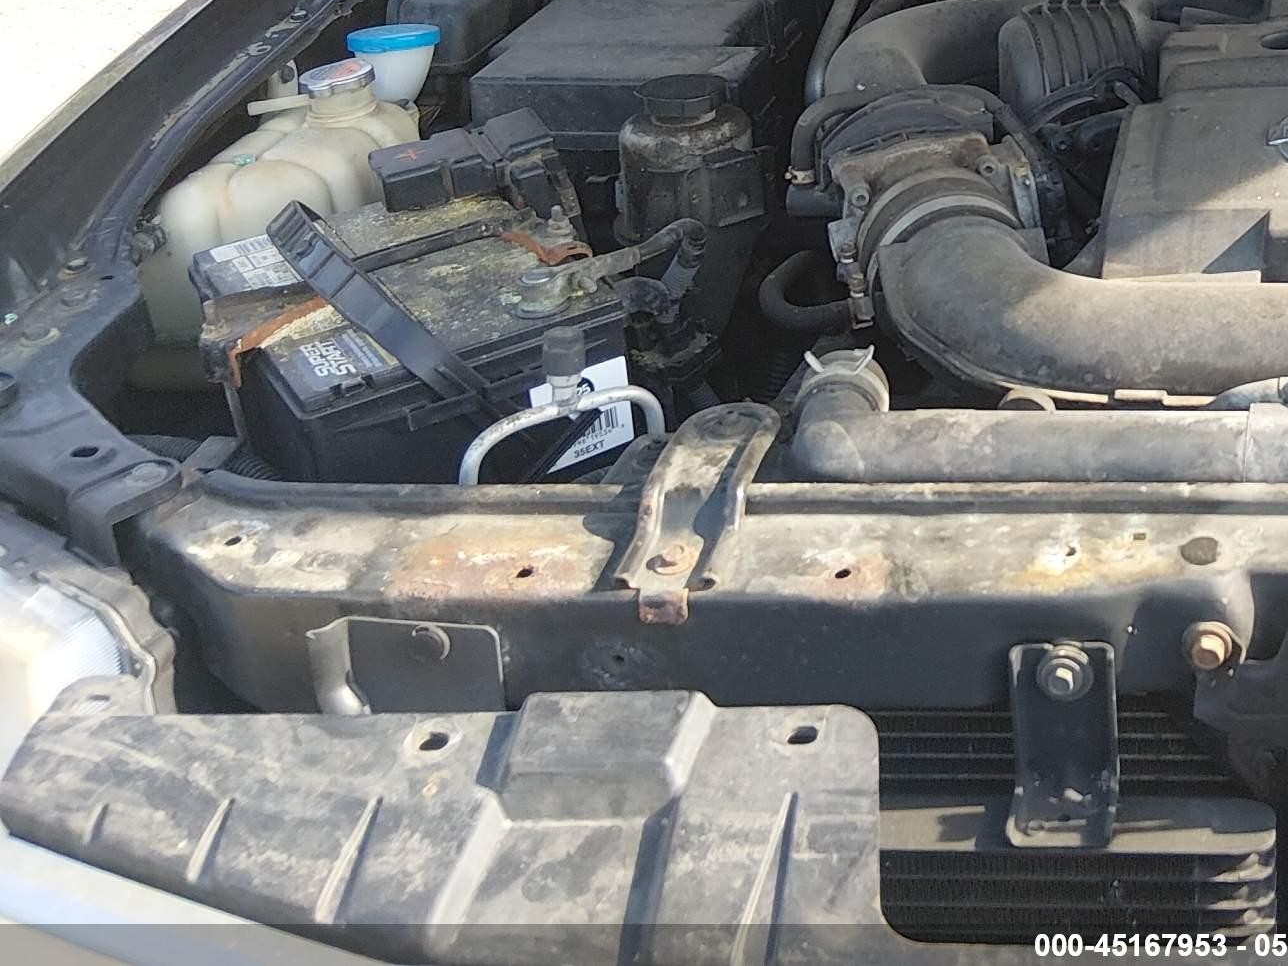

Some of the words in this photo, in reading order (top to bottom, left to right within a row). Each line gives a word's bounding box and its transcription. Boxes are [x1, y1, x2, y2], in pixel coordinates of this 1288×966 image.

[300, 341, 330, 377] SUPER
[315, 340, 357, 376] START
[573, 439, 606, 459] 35EXT
